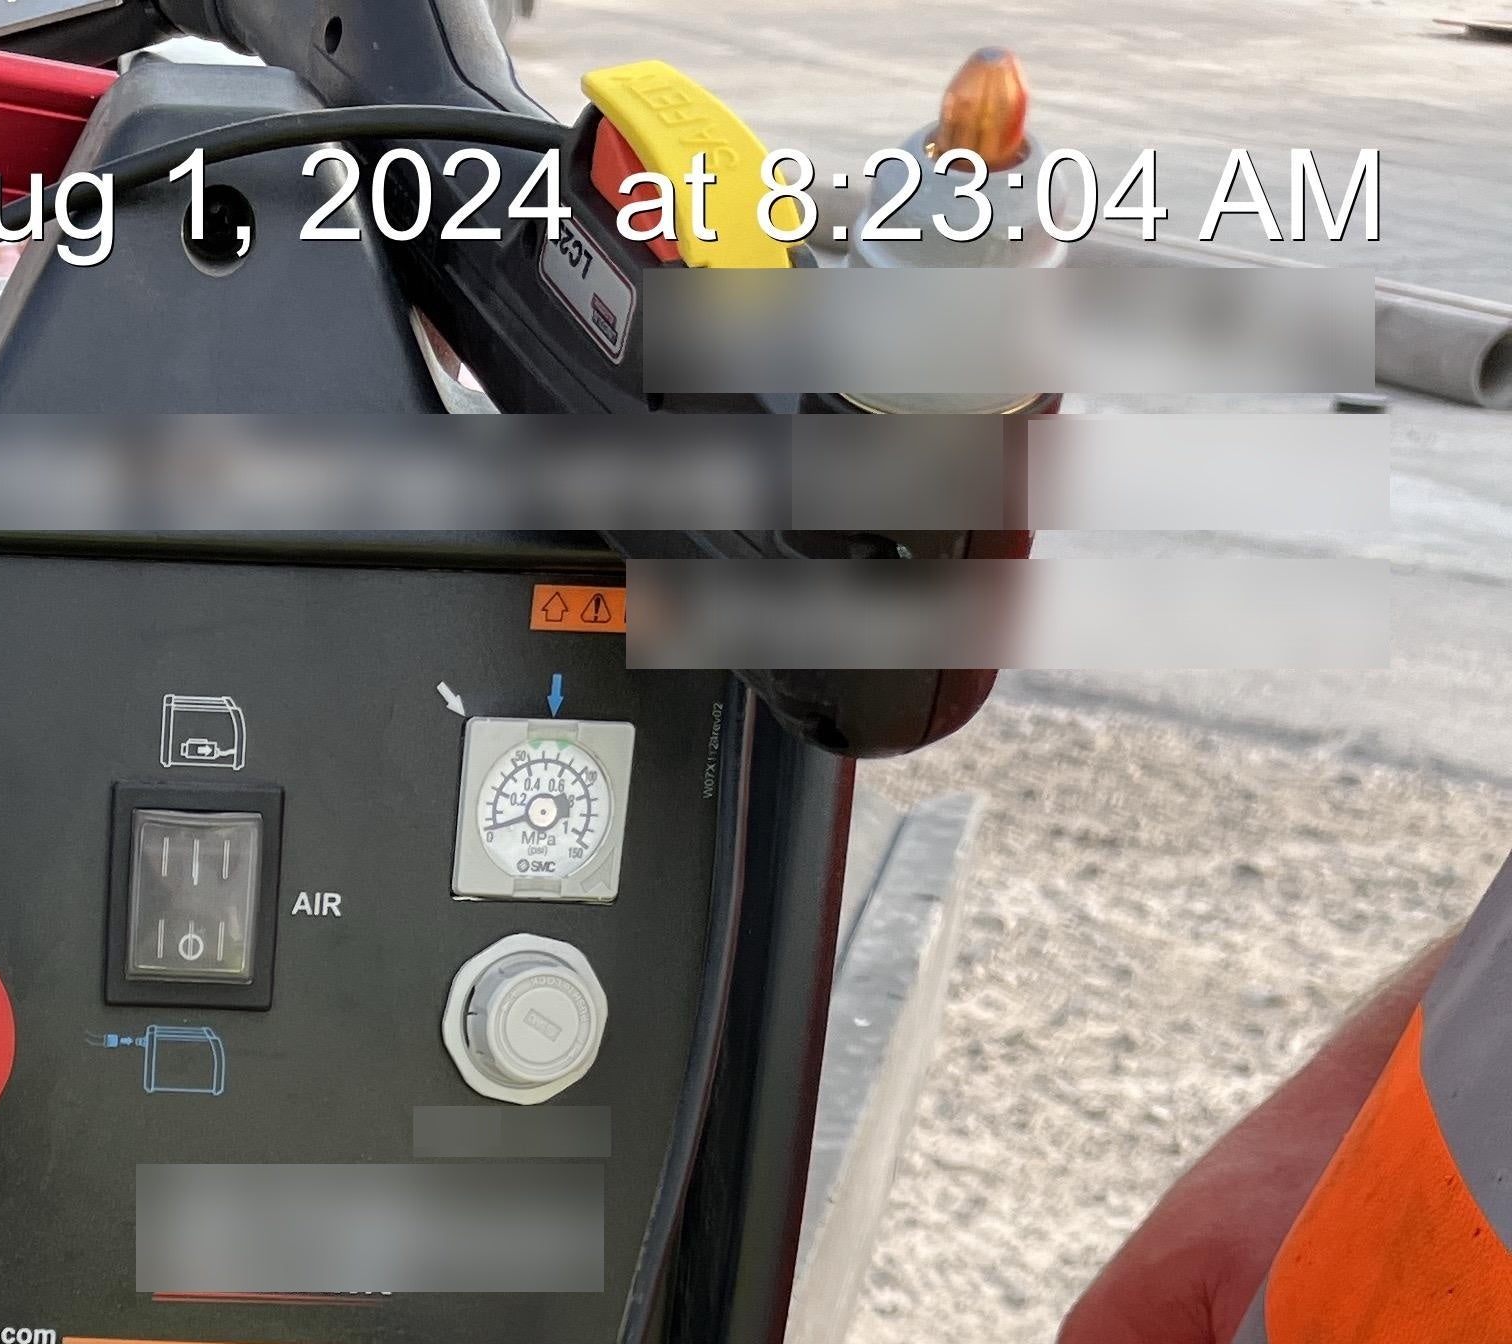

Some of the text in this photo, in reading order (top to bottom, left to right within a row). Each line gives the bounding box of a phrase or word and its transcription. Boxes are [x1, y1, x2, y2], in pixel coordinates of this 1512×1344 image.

[611, 74, 737, 170] SAFETY
[523, 777, 541, 791] 0.4
[548, 778, 565, 793] 0.6
[510, 792, 527, 807] 0.2
[521, 831, 556, 846] MPa
[568, 847, 584, 859] 150
[530, 861, 556, 873] SMC
[291, 891, 342, 917] AIR
